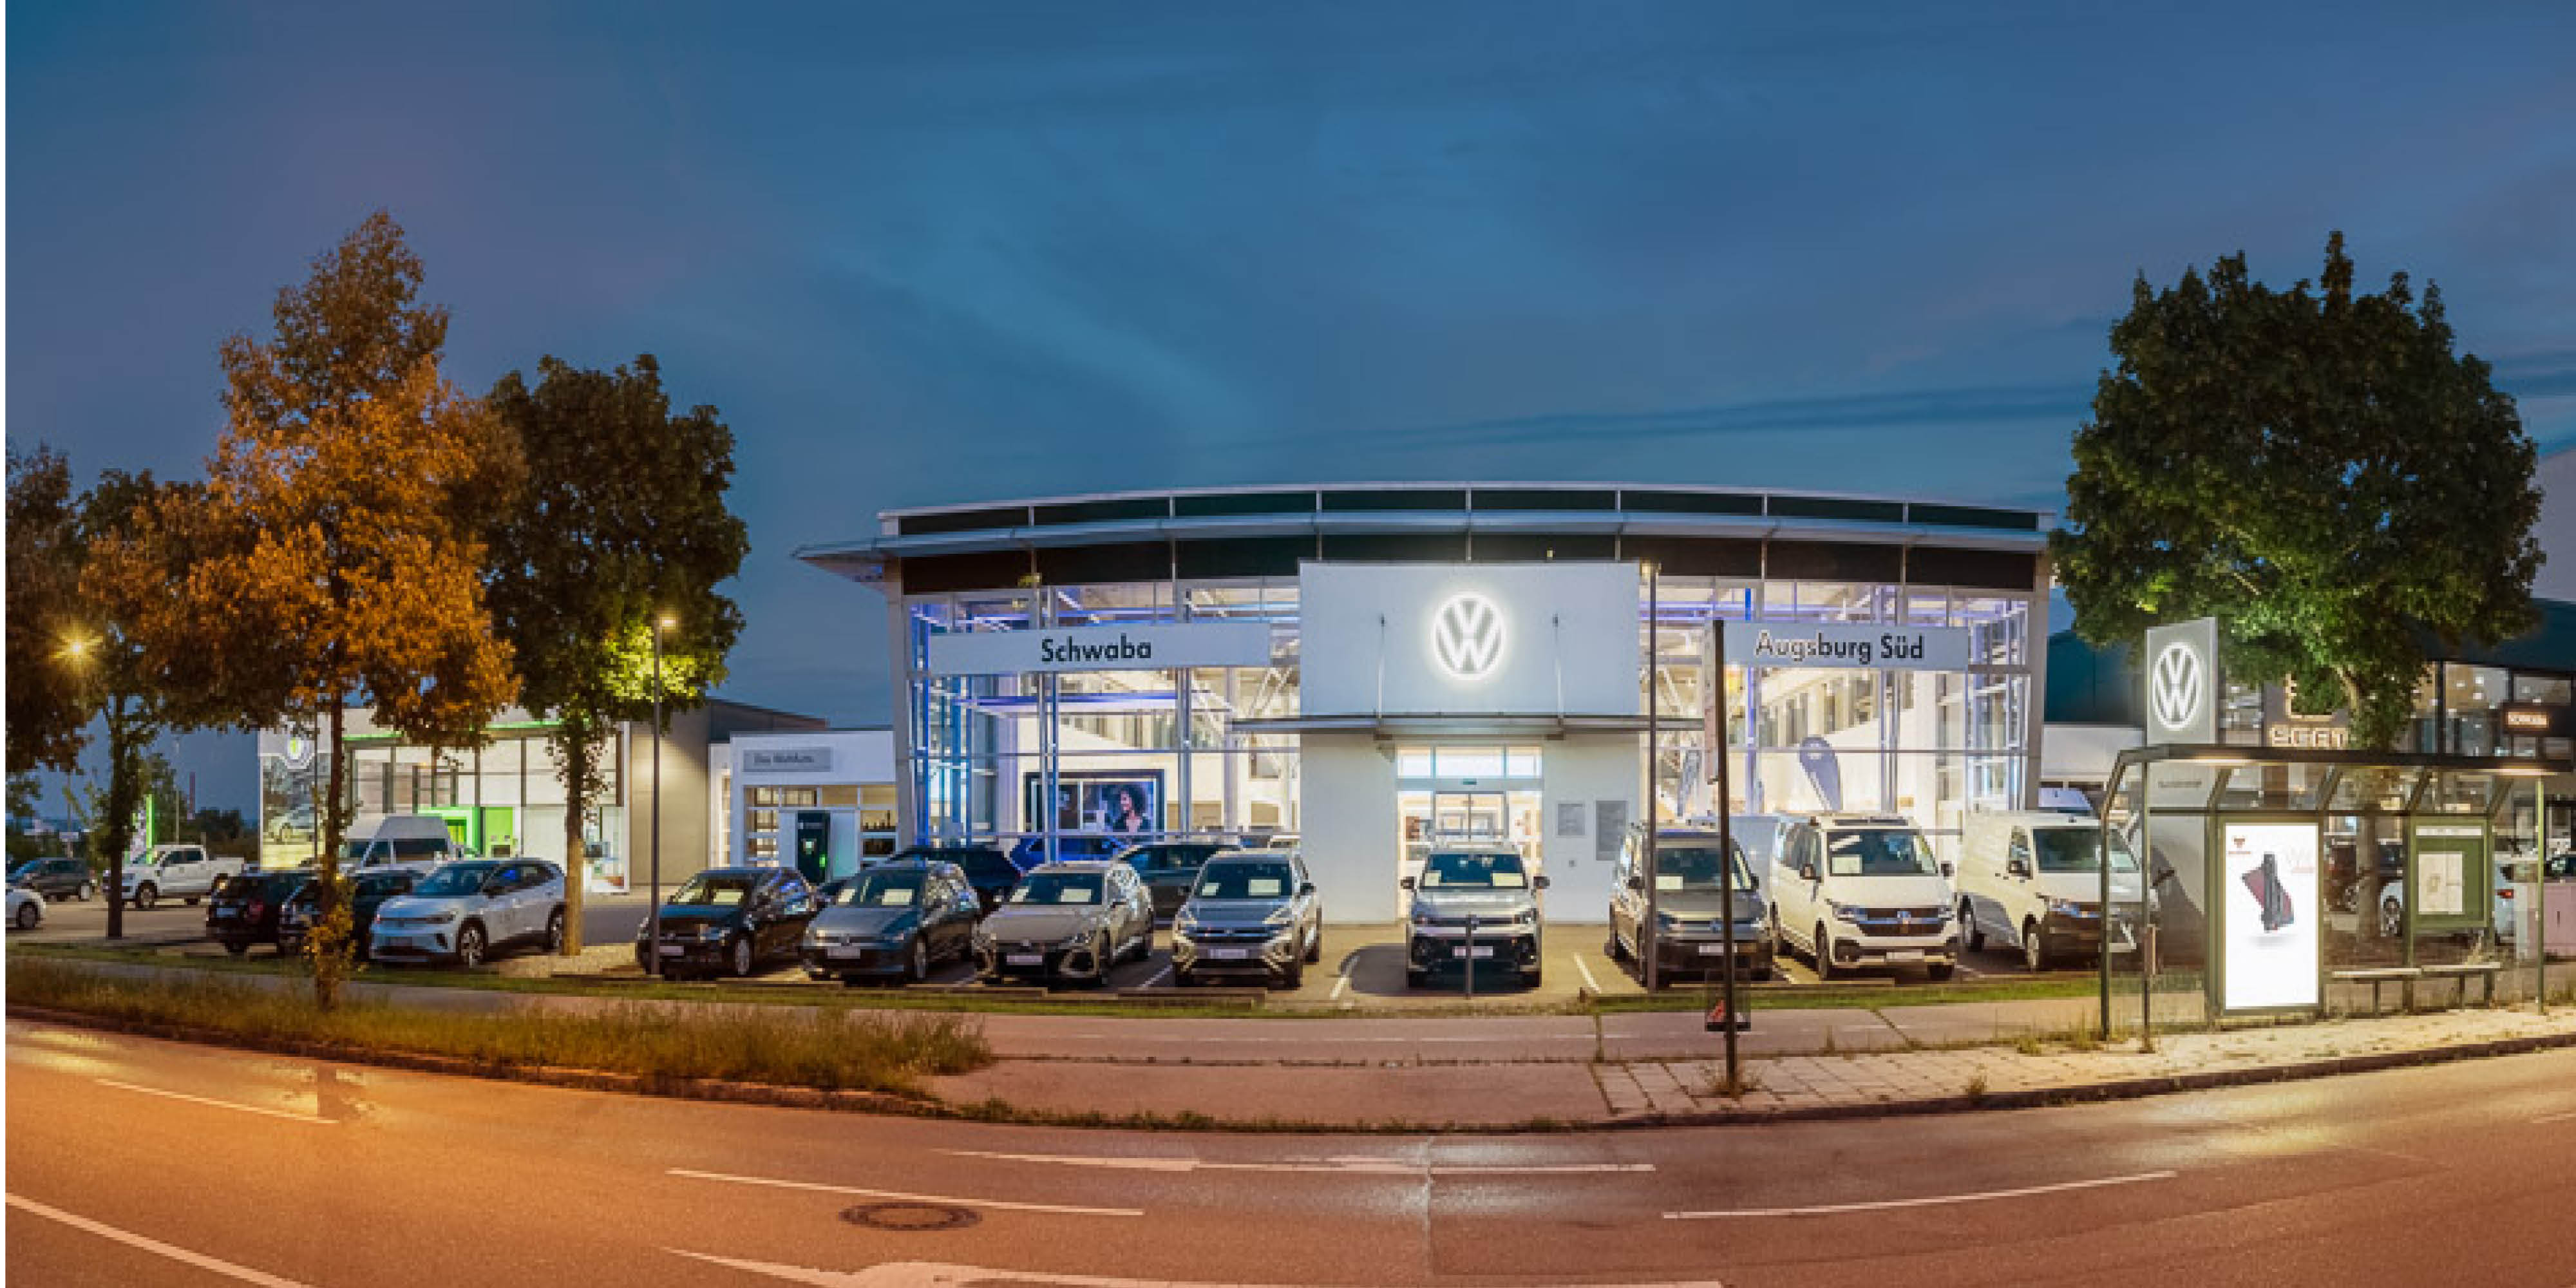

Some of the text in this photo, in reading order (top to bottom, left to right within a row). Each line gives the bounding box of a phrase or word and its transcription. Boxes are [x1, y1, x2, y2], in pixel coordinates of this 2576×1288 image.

[1041, 632, 1151, 663] Schwaba
[1756, 629, 1924, 665] Augsburg Süd
